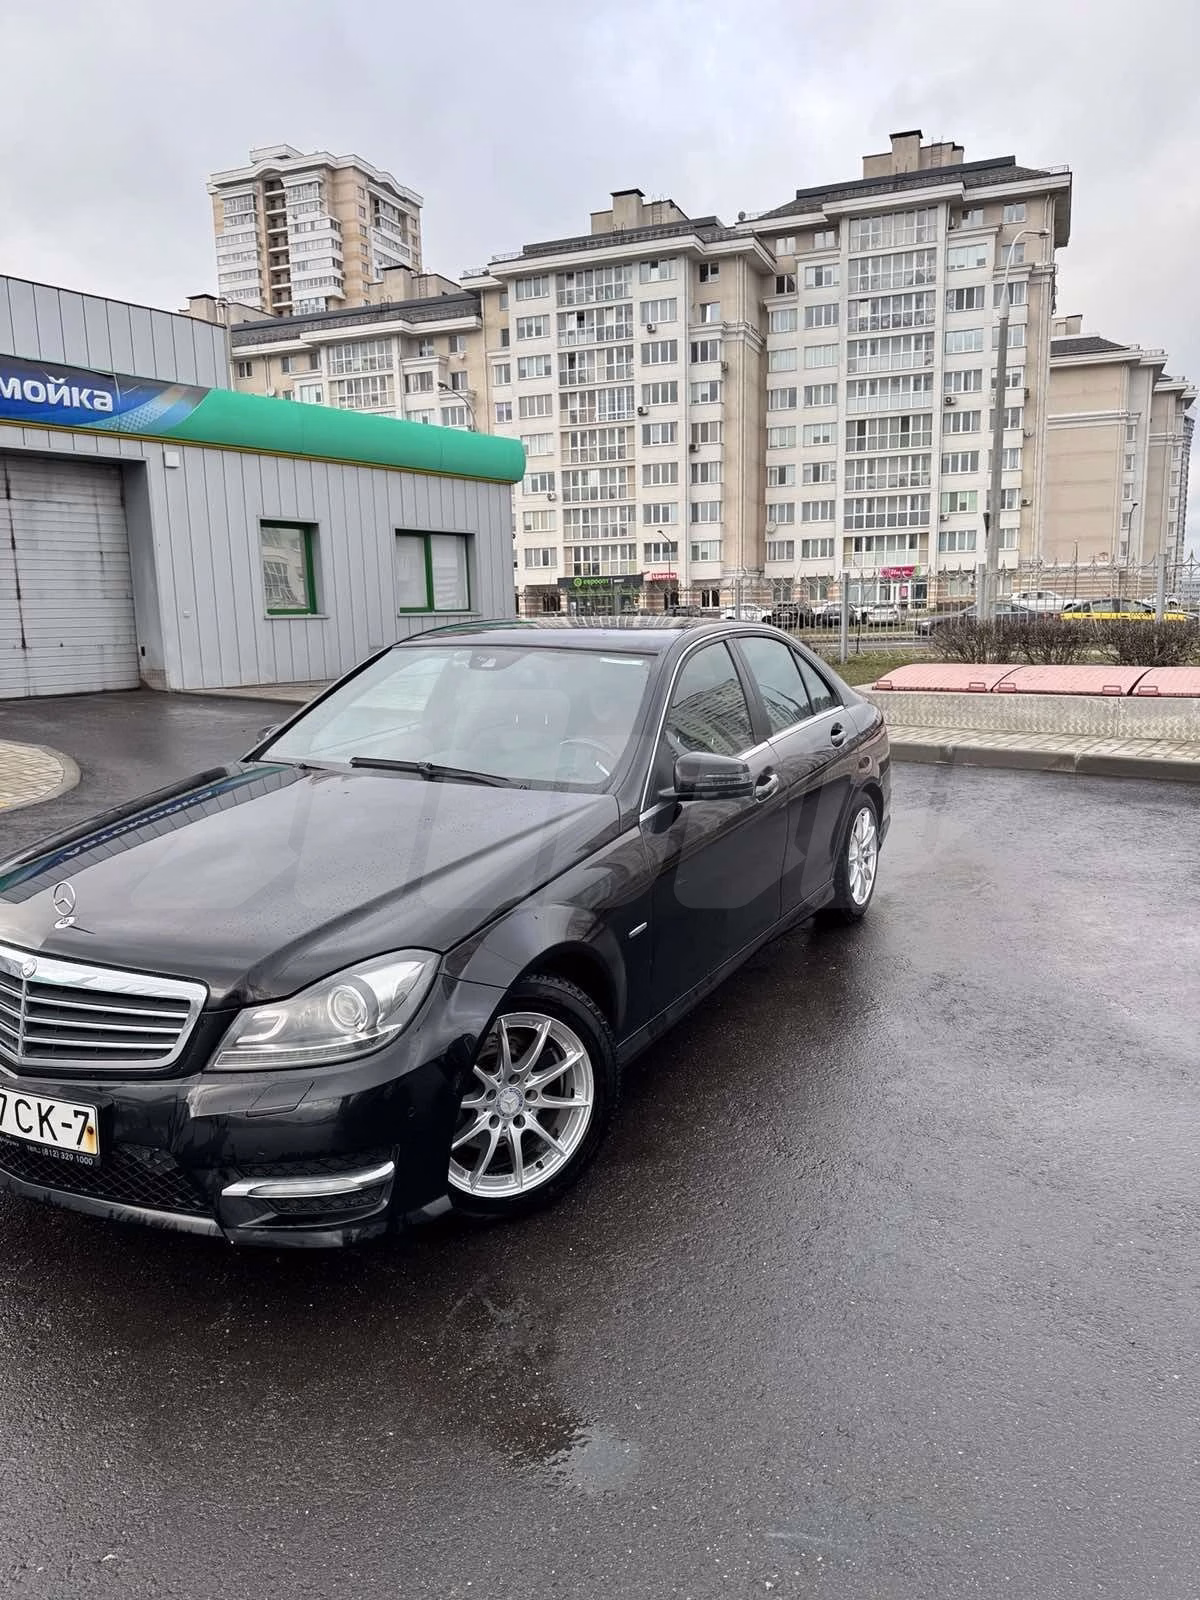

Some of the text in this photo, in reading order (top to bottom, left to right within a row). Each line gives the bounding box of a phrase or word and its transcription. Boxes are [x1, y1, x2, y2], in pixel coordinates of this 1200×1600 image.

[42, 1147, 60, 1159] (812)
[61, 1151, 74, 1162] 329
[76, 1154, 94, 1166] 1000
